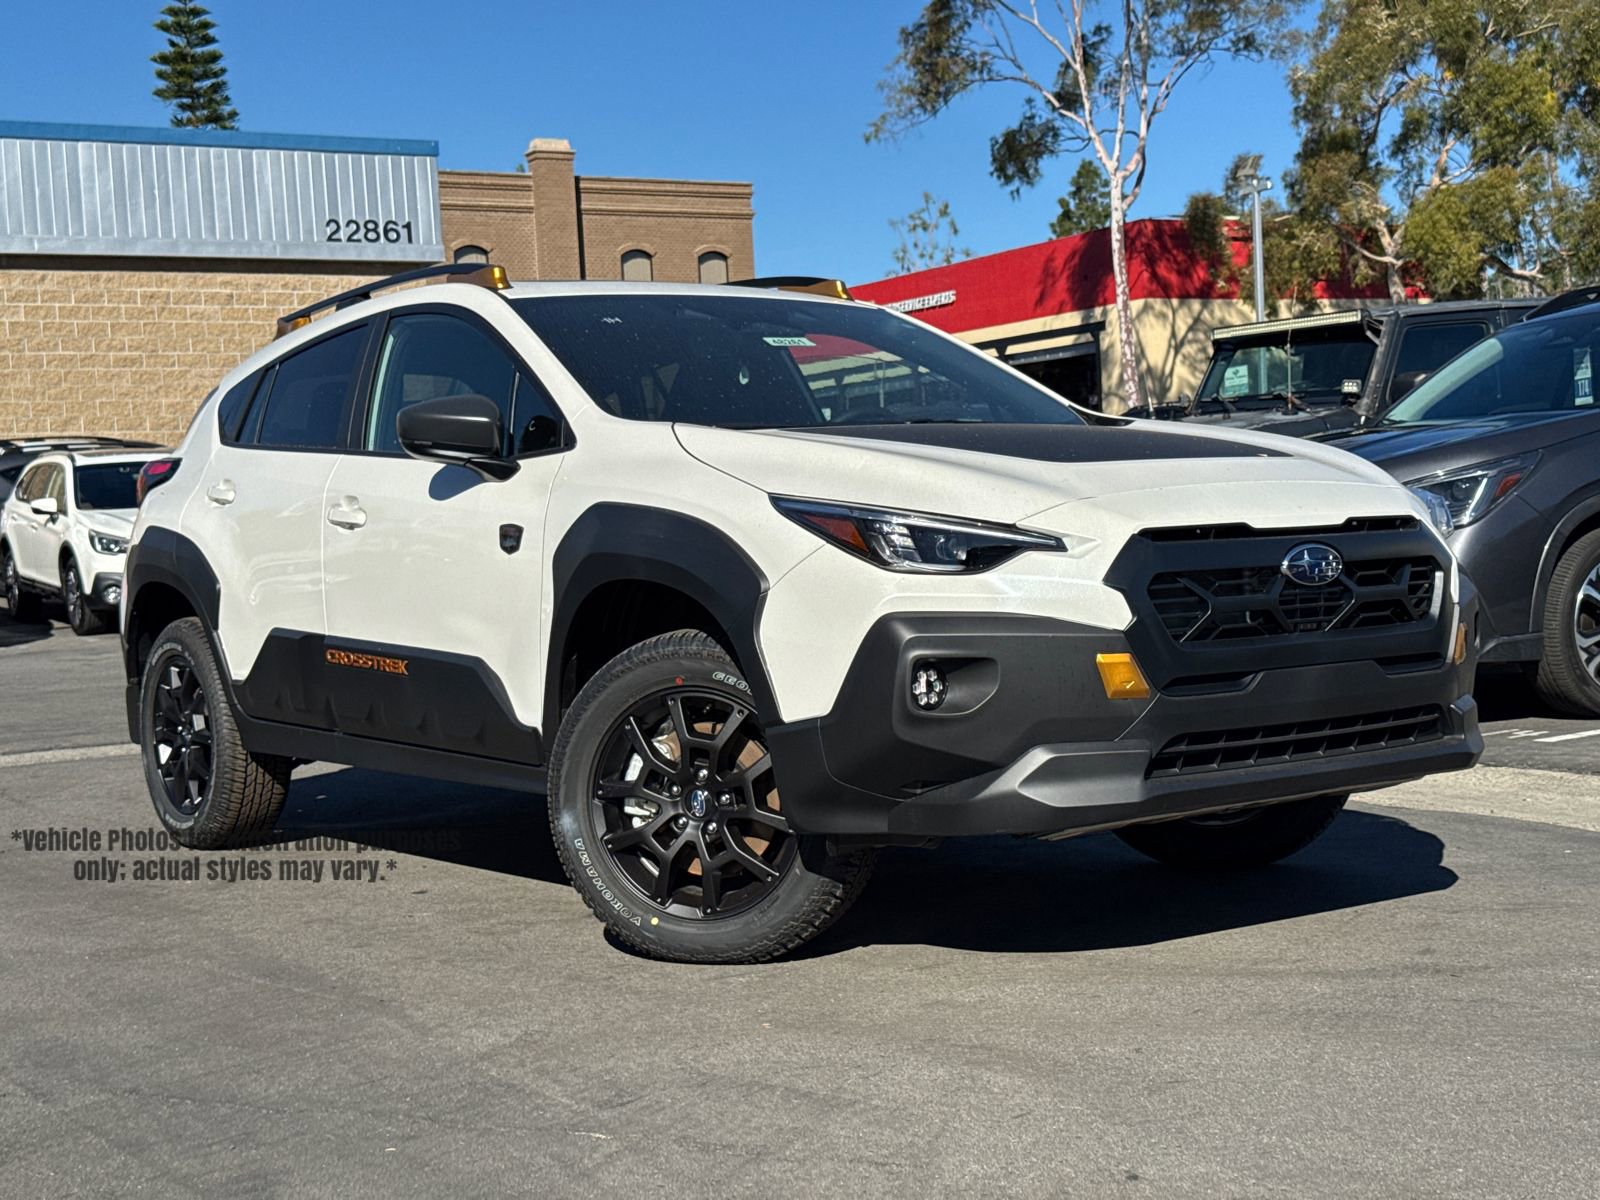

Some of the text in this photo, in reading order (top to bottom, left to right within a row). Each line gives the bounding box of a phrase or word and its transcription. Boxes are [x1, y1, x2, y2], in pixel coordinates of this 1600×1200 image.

[325, 218, 413, 244] 22861
[326, 648, 409, 676] CROSSTREK
[574, 838, 642, 926] YOKOHAMA
